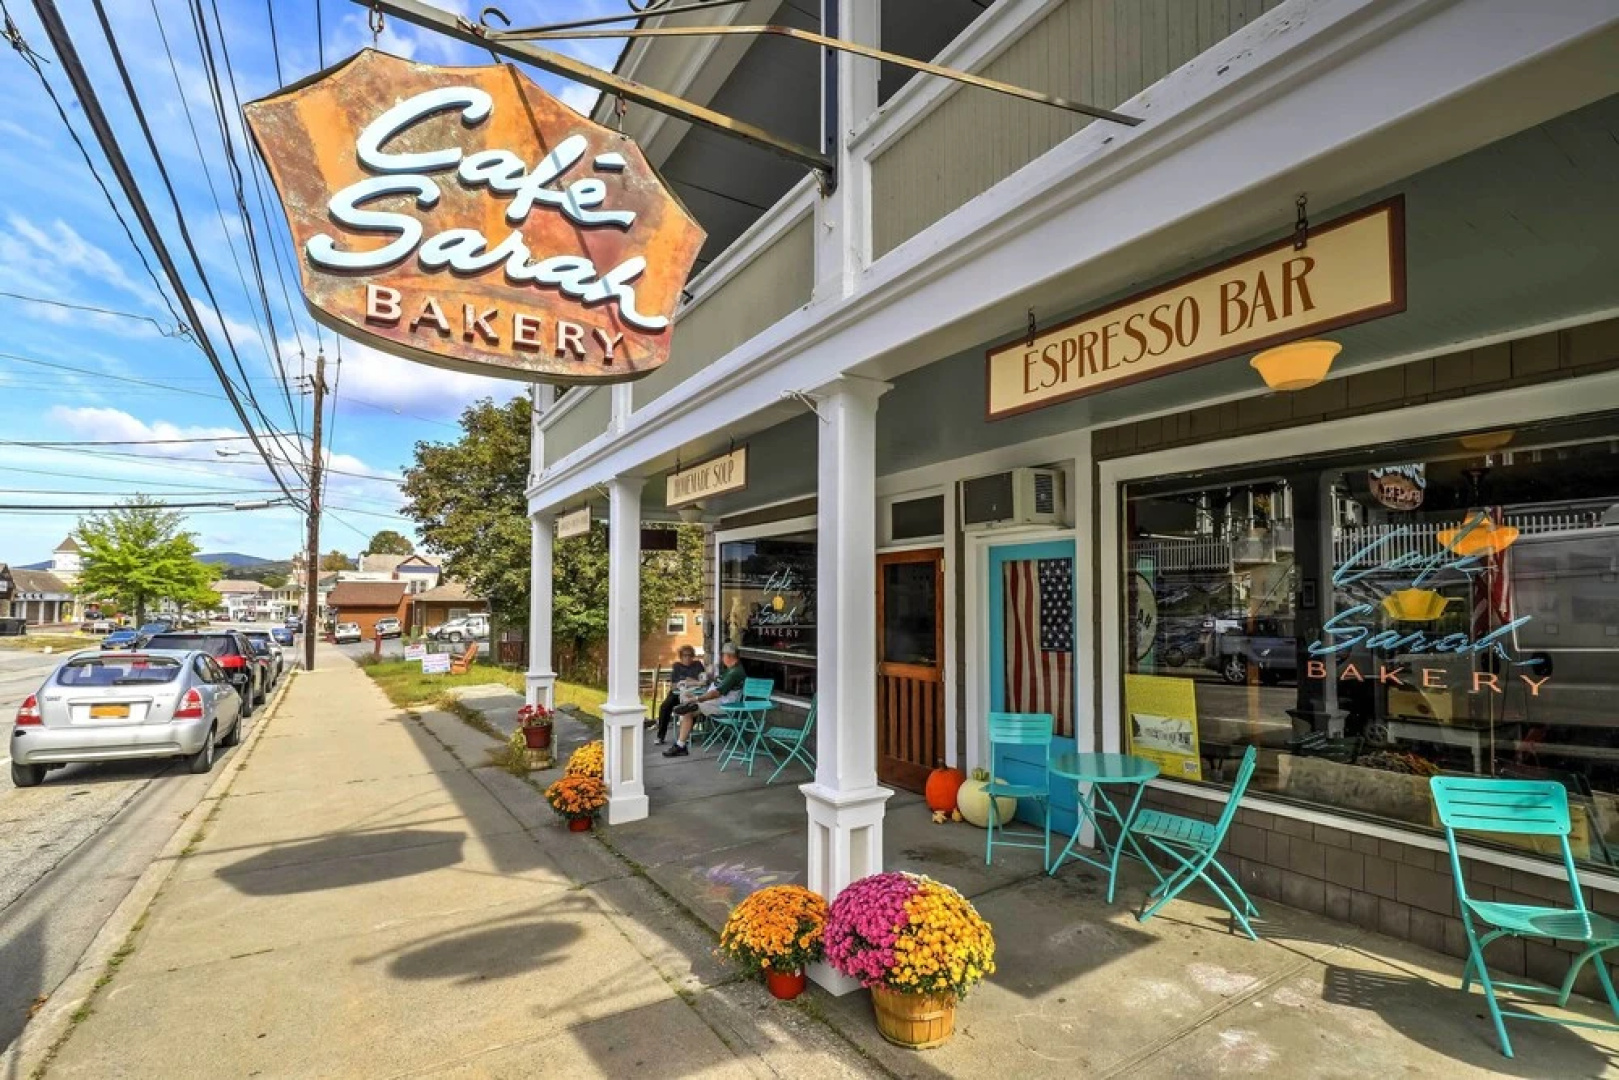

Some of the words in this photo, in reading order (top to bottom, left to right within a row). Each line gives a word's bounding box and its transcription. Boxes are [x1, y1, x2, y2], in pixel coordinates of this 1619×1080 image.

[356, 85, 636, 230] Café
[306, 174, 670, 332] Sarah
[364, 284, 625, 365] BAKERY
[1023, 296, 1201, 395] ESPRESSO
[1219, 255, 1317, 337] BAR
[712, 459, 734, 488] SOUP
[1308, 603, 1546, 667] Sarah
[1307, 660, 1550, 696] BAKERY
